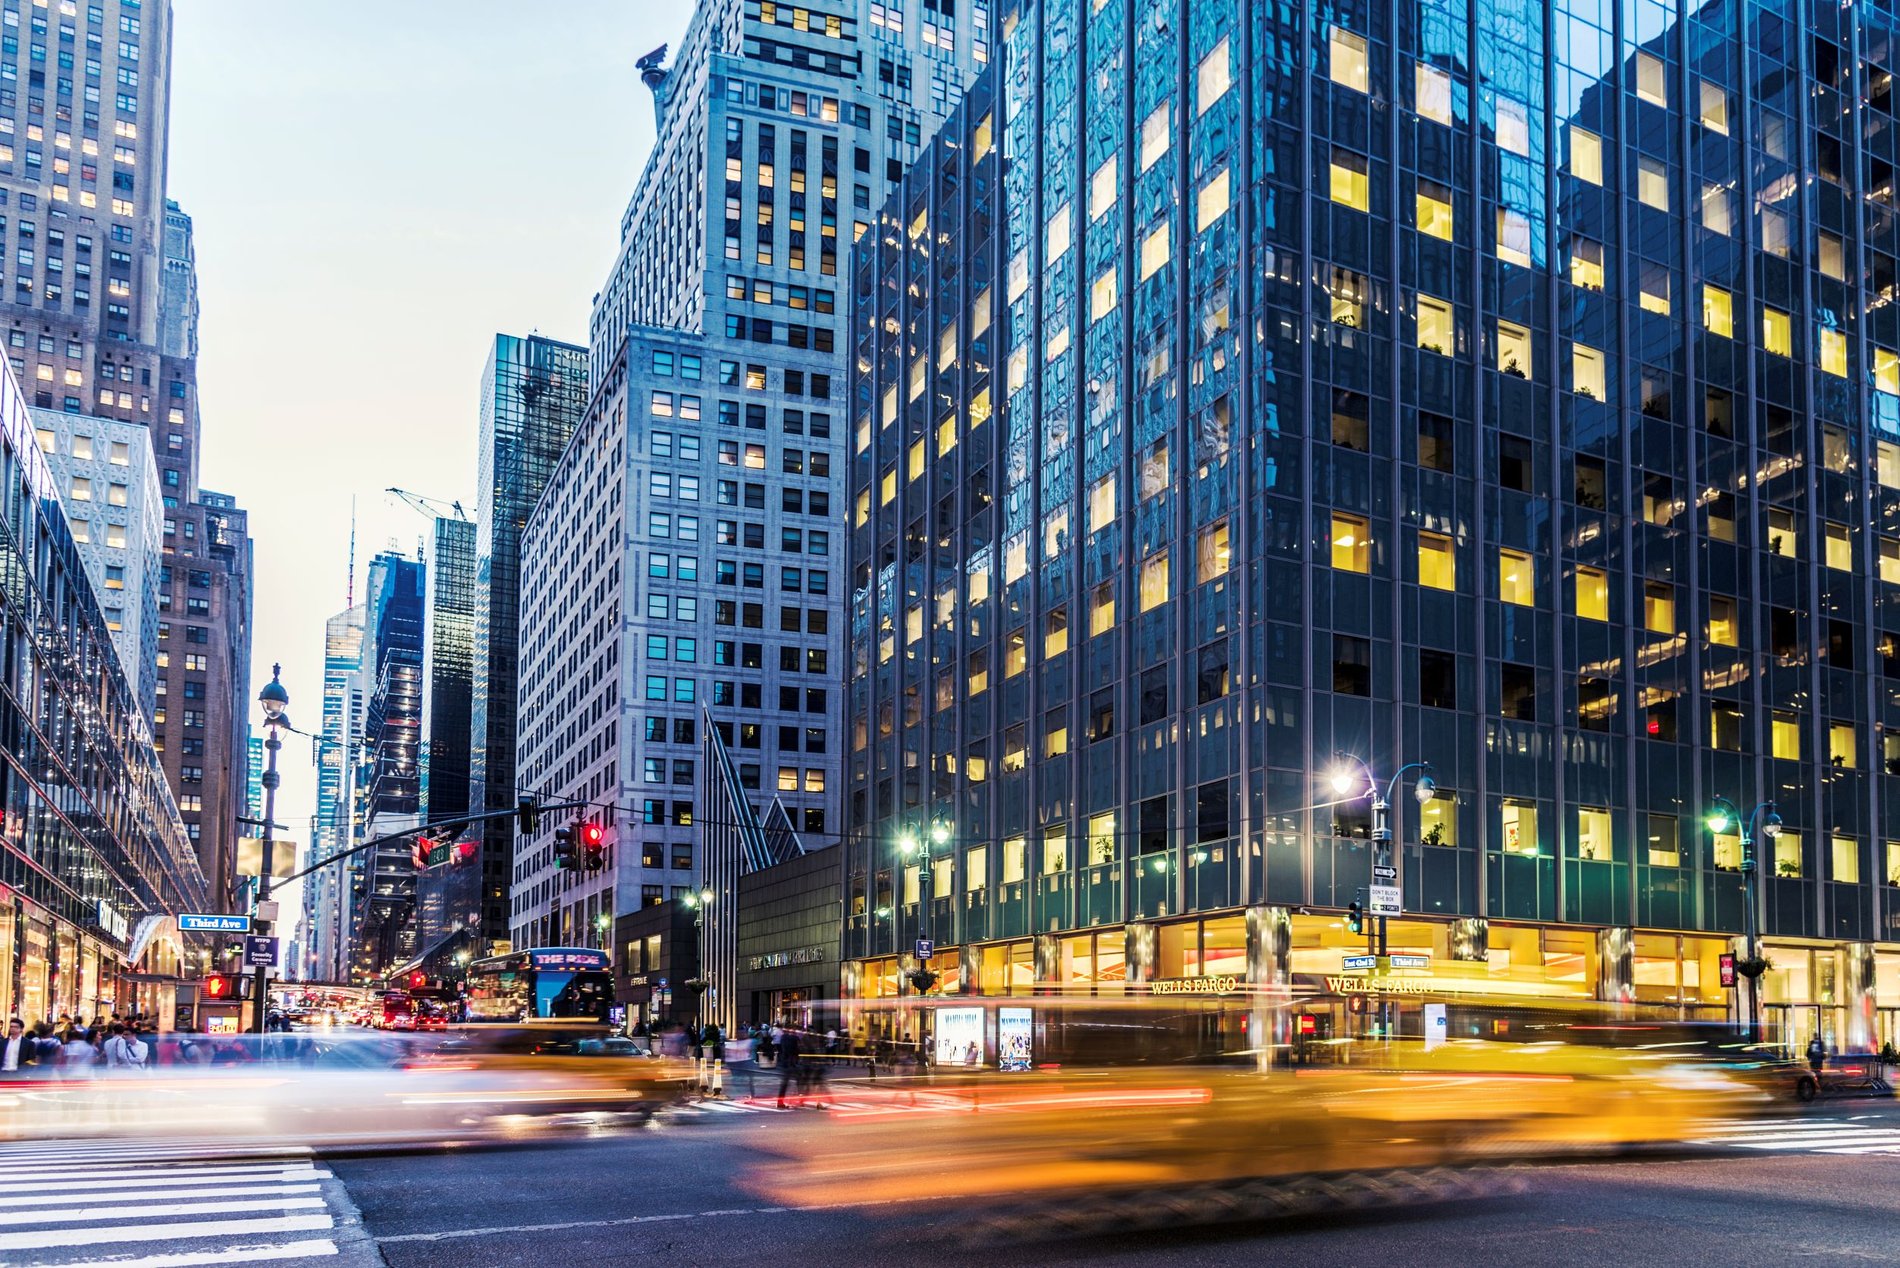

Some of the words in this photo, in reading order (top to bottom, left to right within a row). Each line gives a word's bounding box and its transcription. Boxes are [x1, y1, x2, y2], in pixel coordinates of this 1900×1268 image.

[188, 918, 219, 928] Third
[221, 919, 241, 928] Ave
[251, 951, 273, 959] Security
[536, 954, 564, 964] THE
[566, 954, 600, 965] RIDE
[1344, 959, 1356, 967] East
[1394, 958, 1412, 966] Third
[1151, 980, 1193, 995] WELLS
[1193, 976, 1236, 992] FARGO
[1325, 976, 1380, 992] WELLS
[1385, 980, 1434, 994] FARGO
